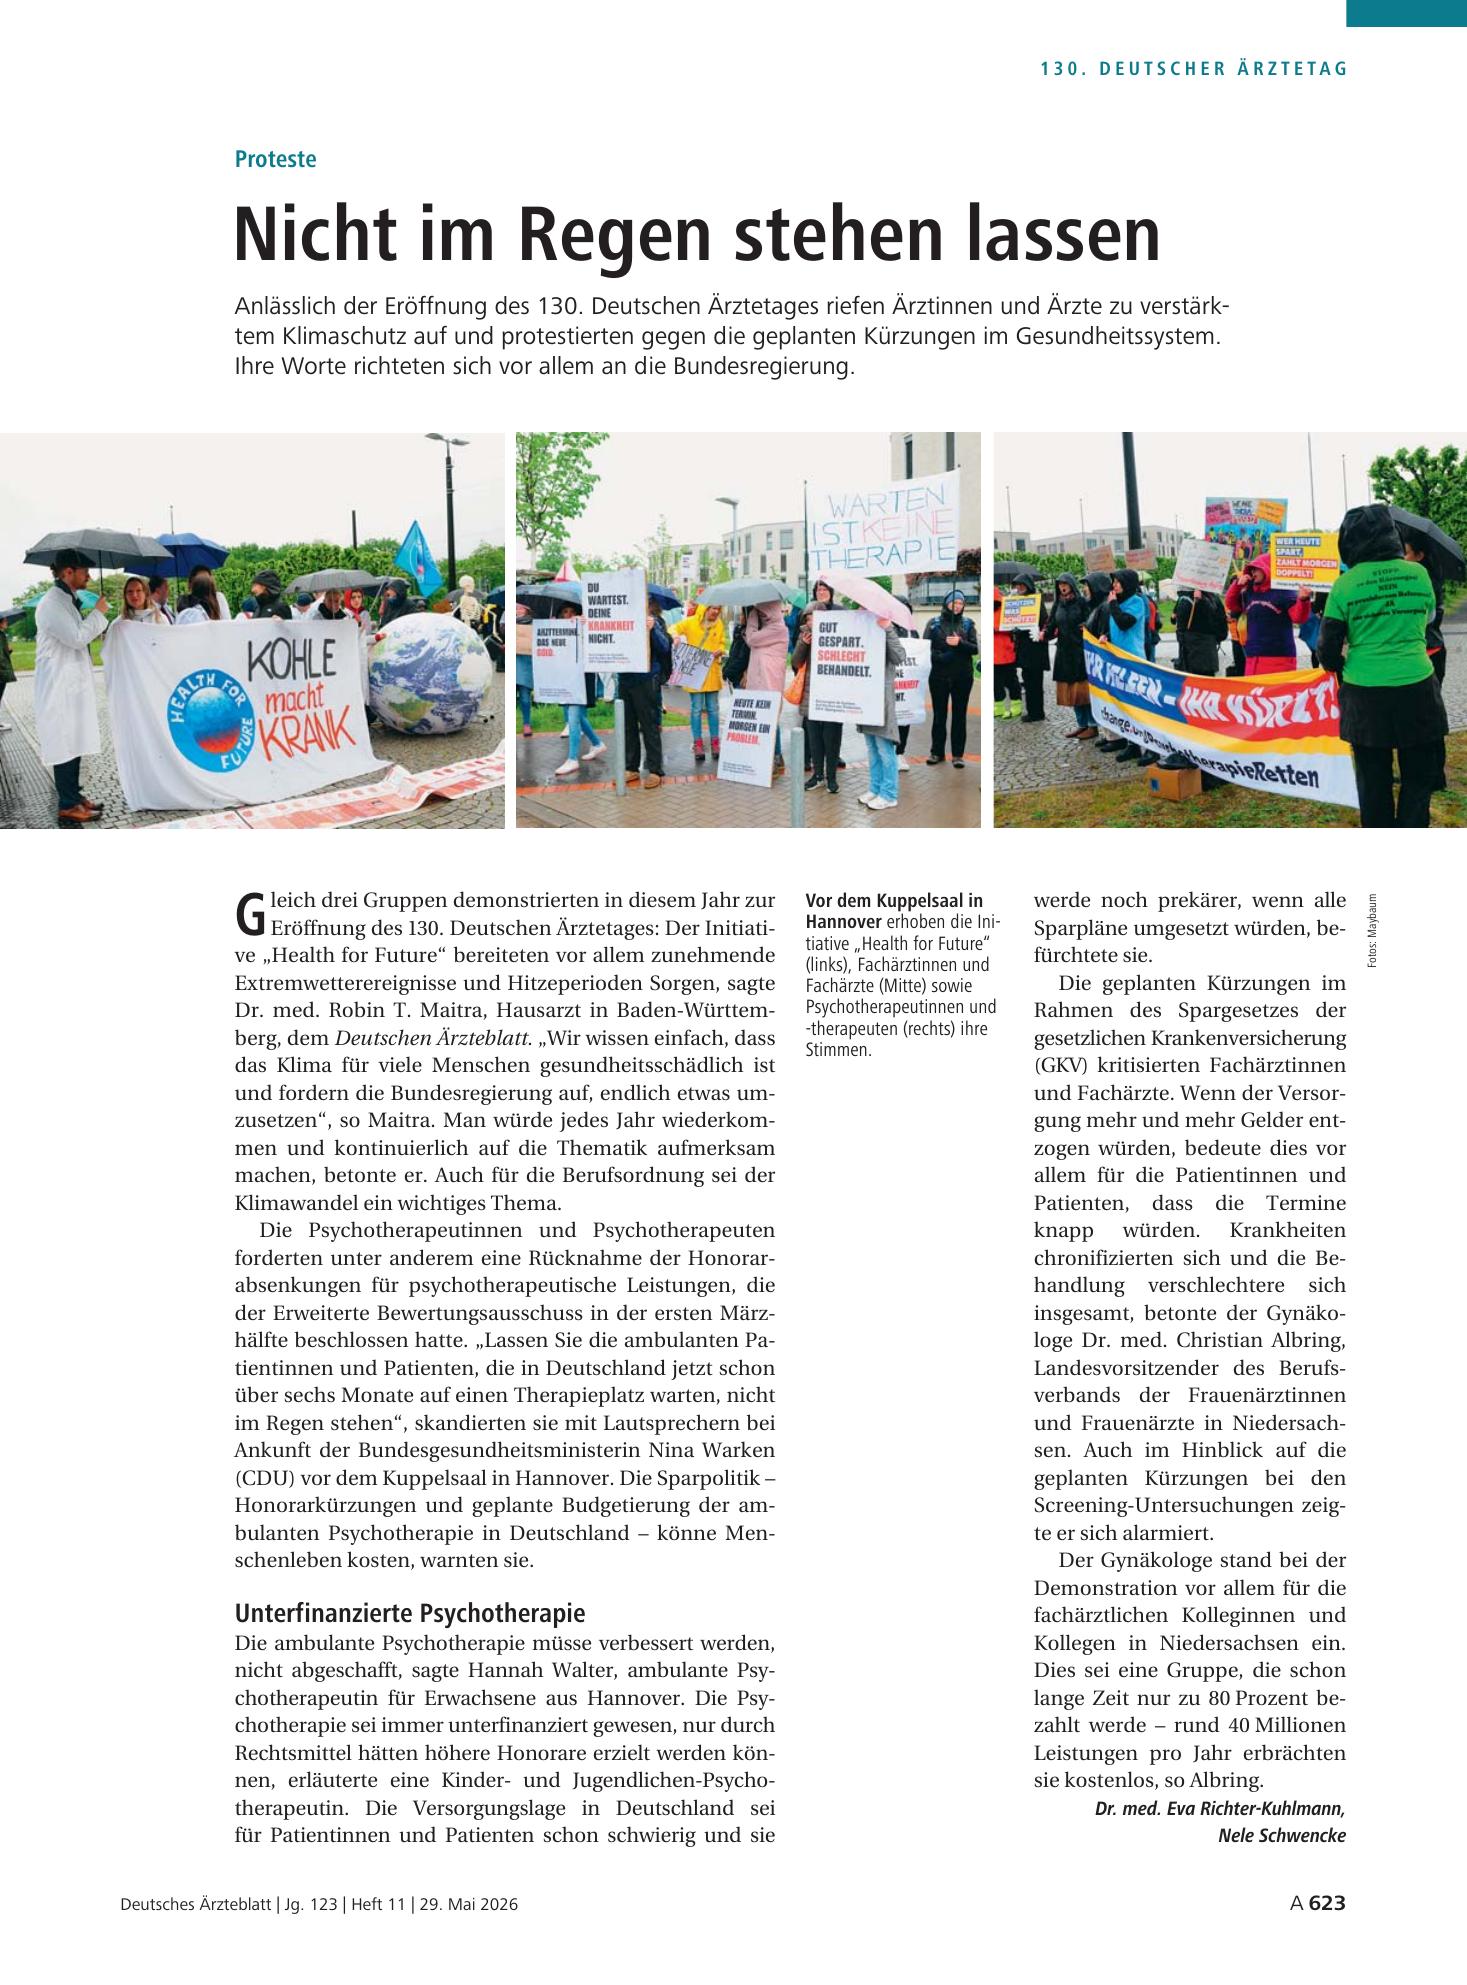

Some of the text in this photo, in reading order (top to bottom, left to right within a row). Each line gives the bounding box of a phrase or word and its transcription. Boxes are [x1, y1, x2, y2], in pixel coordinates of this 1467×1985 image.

[1042, 58, 1345, 75] 130. DEUTSCHER ÄRZTETAG
[236, 150, 316, 167] Proteste
[237, 202, 1158, 278] Nicht im Regen stehen lassen
[235, 293, 1229, 320] Anlässlich der Eröffnung des 130. Deutschen Ärztetages riefen Ärztinnen und Ärzte zu verstärk-
[236, 356, 854, 380] Ihre Worte richteten sich vor allem an die Bundesregierung.
[828, 482, 945, 518] WARTEN
[1276, 537, 1320, 546] WER HEUTE
[810, 535, 956, 570] THERAPIE
[1302, 559, 1337, 568] MORGEN
[587, 582, 600, 592] DU
[588, 595, 629, 606] WARTEST.
[588, 608, 612, 618] DEINE
[588, 620, 634, 631] KRANKHEIT
[820, 622, 838, 634] GUT
[551, 638, 566, 646] NEUE
[588, 634, 616, 644] NICHT.
[818, 636, 864, 648] GESPART.
[248, 637, 336, 682] KOHLE
[818, 650, 866, 662] SCHLECHT
[816, 664, 872, 678] BEHANDELT.
[266, 680, 325, 714] macht
[733, 698, 772, 710] HEUTE KEIN
[1179, 686, 1227, 721] IHR
[170, 673, 254, 770] HEALTH FOR FUTURE
[731, 709, 758, 721] TERMIN.
[258, 704, 356, 762] KRANK
[728, 720, 770, 734] MORGEN EIN
[726, 732, 760, 746] PROBLEM.
[806, 892, 982, 911] Vor dem Kuppelsaal in
[807, 913, 1000, 928] Hannover erhoben die Ini-
[1367, 894, 1379, 967] Fotos: Maybaum
[806, 935, 989, 953] tiative „Health for Future“
[1034, 946, 1152, 962] fürchtete sie.
[806, 956, 989, 974] (links), Fachärztinnen und
[807, 977, 972, 995] Fachärzte (Mitte) sowie
[807, 998, 996, 1017] Psychotherapeutinnen und
[806, 1020, 987, 1039] -therapeuten (rechts) ihre
[806, 1042, 871, 1056] Stimmen.
[235, 1195, 561, 1215] Klimawandel ein wichtiges Thema.
[235, 1552, 533, 1570] schenleben kosten, warnten sie.
[236, 1602, 585, 1628] Unterfinanzierte Psychotherapie
[1035, 1772, 1263, 1792] sie kostenlos, so Albring.
[1096, 1800, 1344, 1818] Dr. med. Eva Richter-Kuhlmann,
[1219, 1827, 1346, 1842] Nele Schwencke
[122, 1895, 518, 1914] Deutsches Ärzteblatt Jg. 123 Heft 11 29. Mai 2026
[1290, 1895, 1345, 1910] A 623
